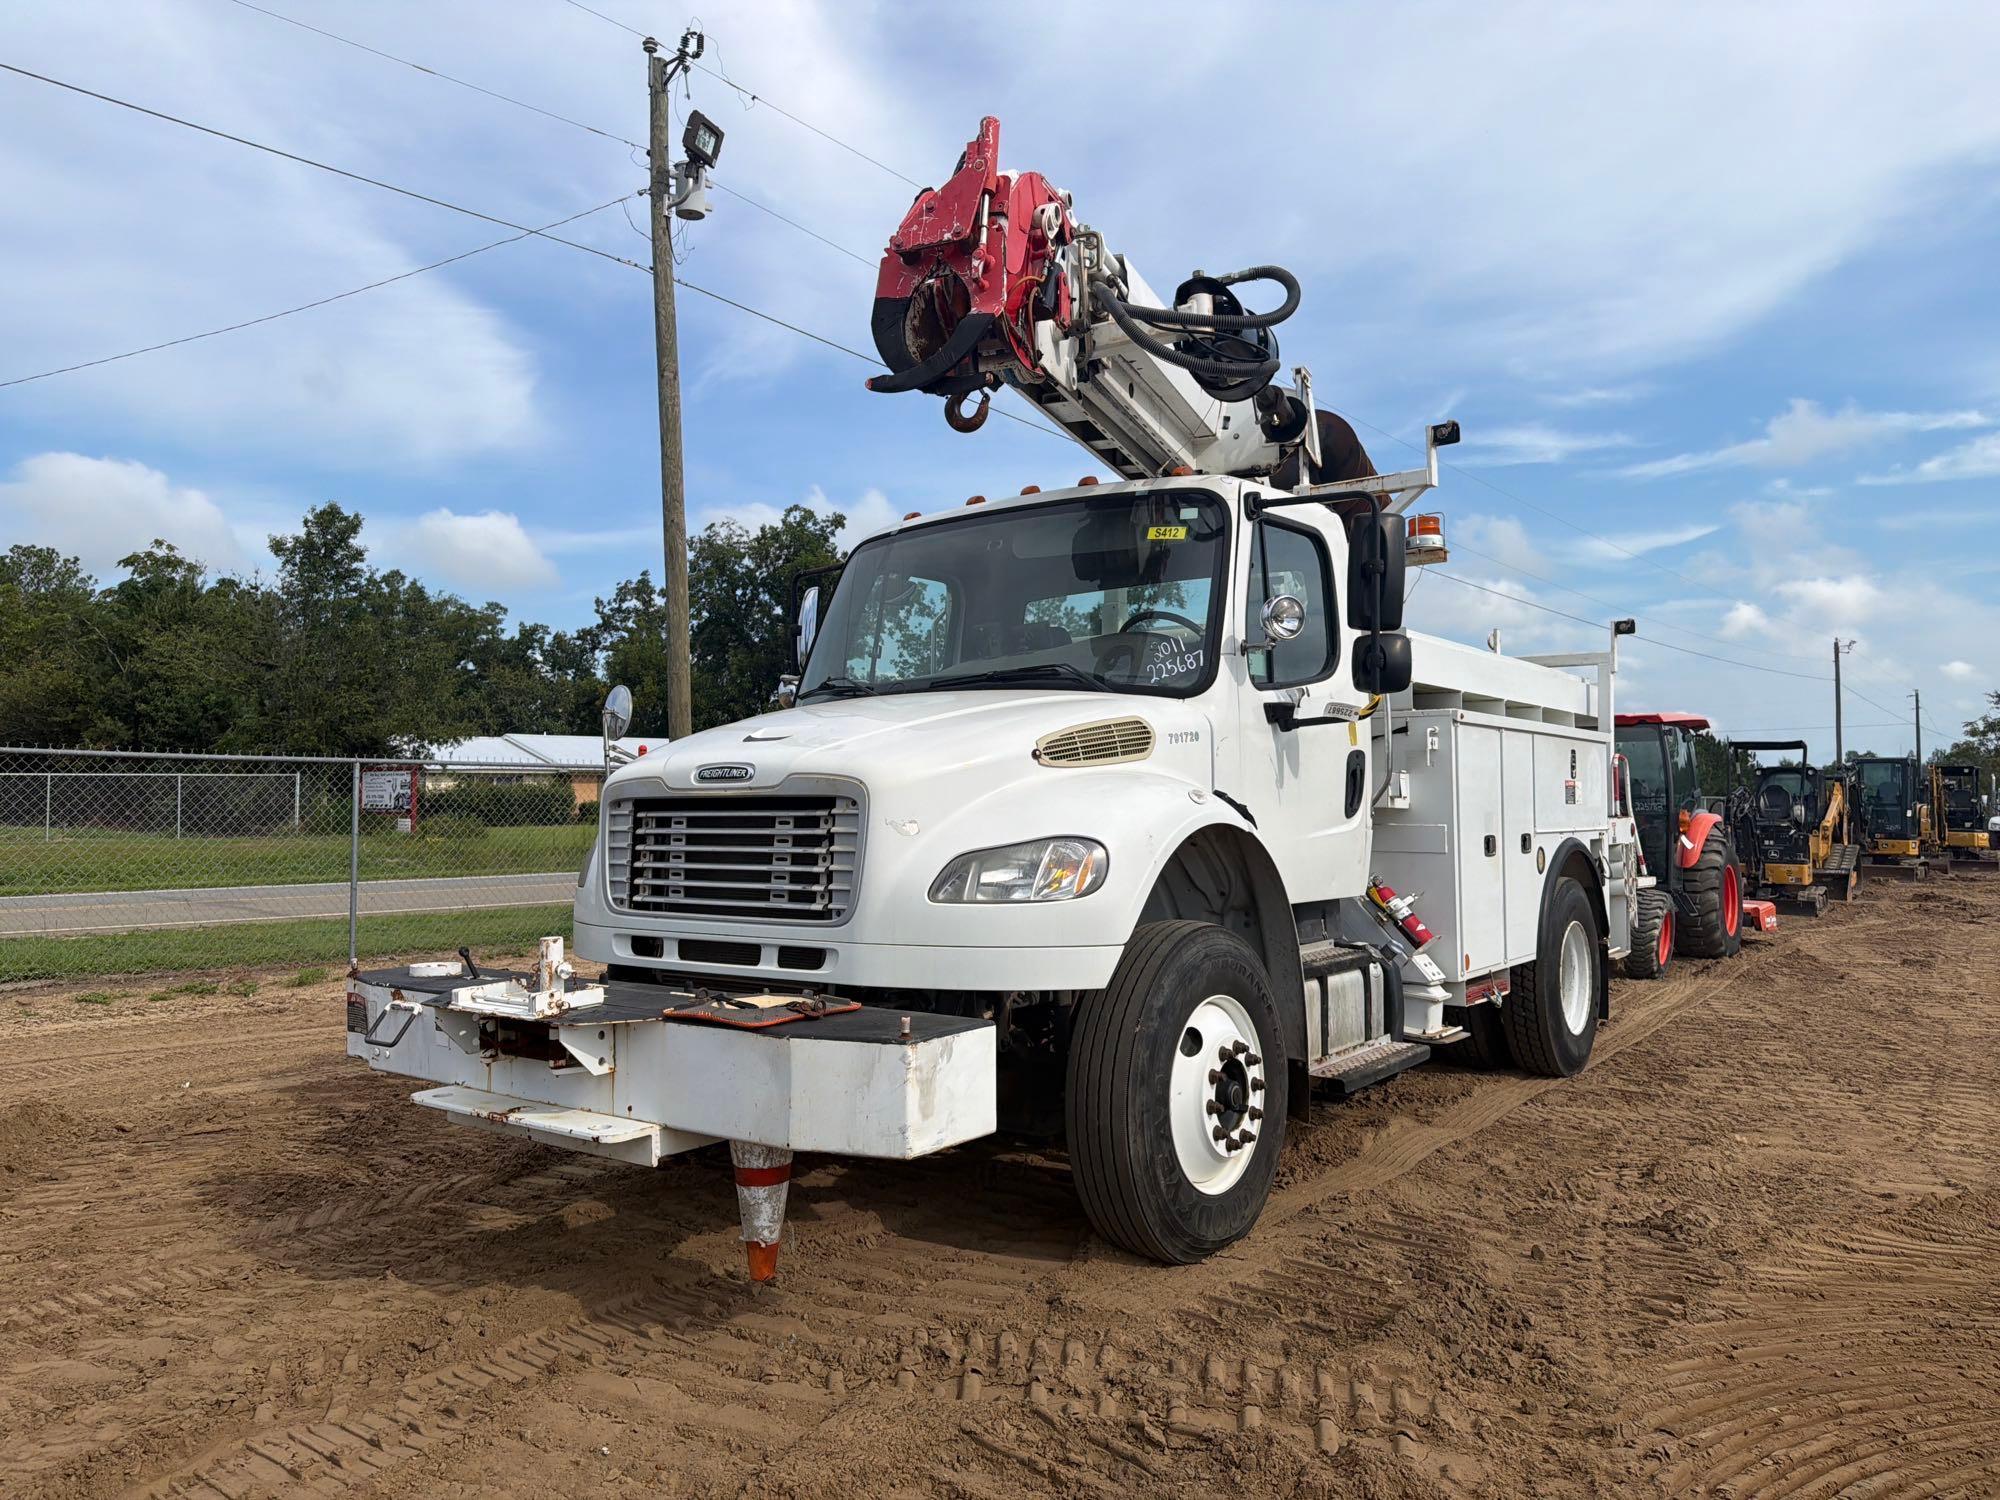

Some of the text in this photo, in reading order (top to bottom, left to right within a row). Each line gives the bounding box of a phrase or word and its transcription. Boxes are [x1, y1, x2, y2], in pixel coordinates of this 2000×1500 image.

[1155, 528, 1179, 538] S412
[1146, 649, 1203, 683] 225687
[700, 768, 747, 778] FREIGHTLINER
